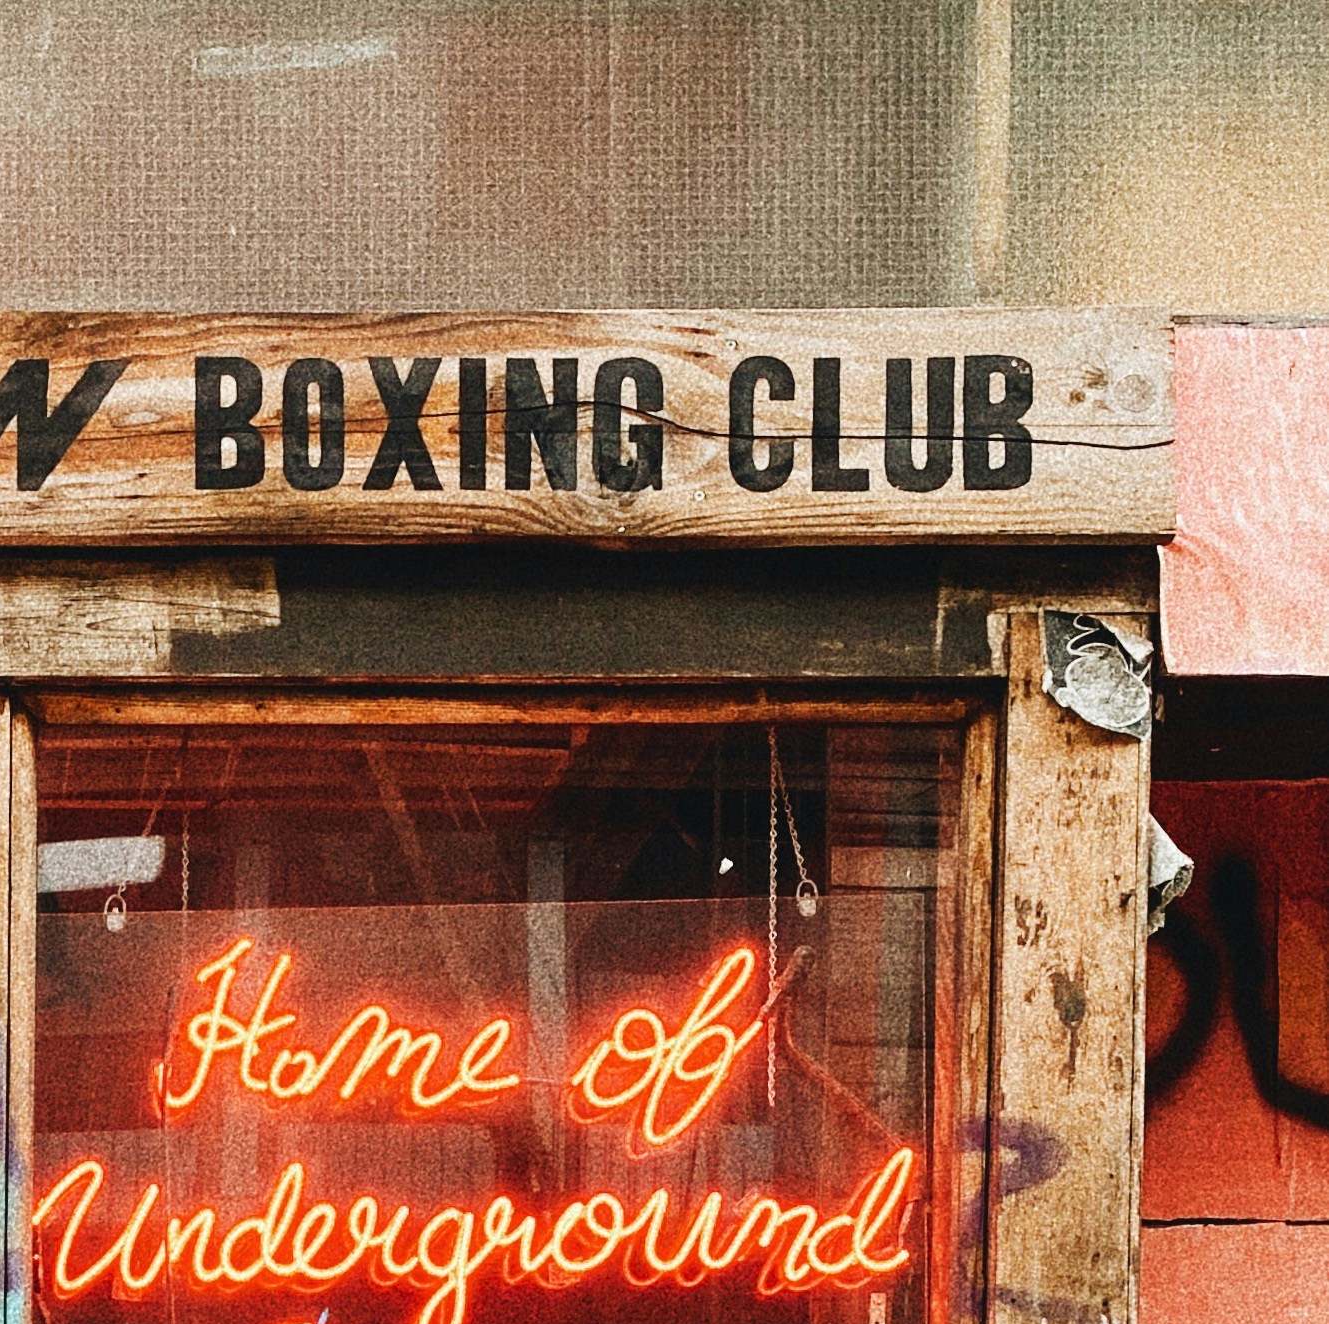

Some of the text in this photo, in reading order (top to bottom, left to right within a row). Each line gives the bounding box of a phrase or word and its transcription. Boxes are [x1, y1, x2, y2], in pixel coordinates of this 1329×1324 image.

[194, 355, 664, 492] BOXING
[728, 354, 1035, 493] CLUB
[164, 938, 763, 1145] Home of
